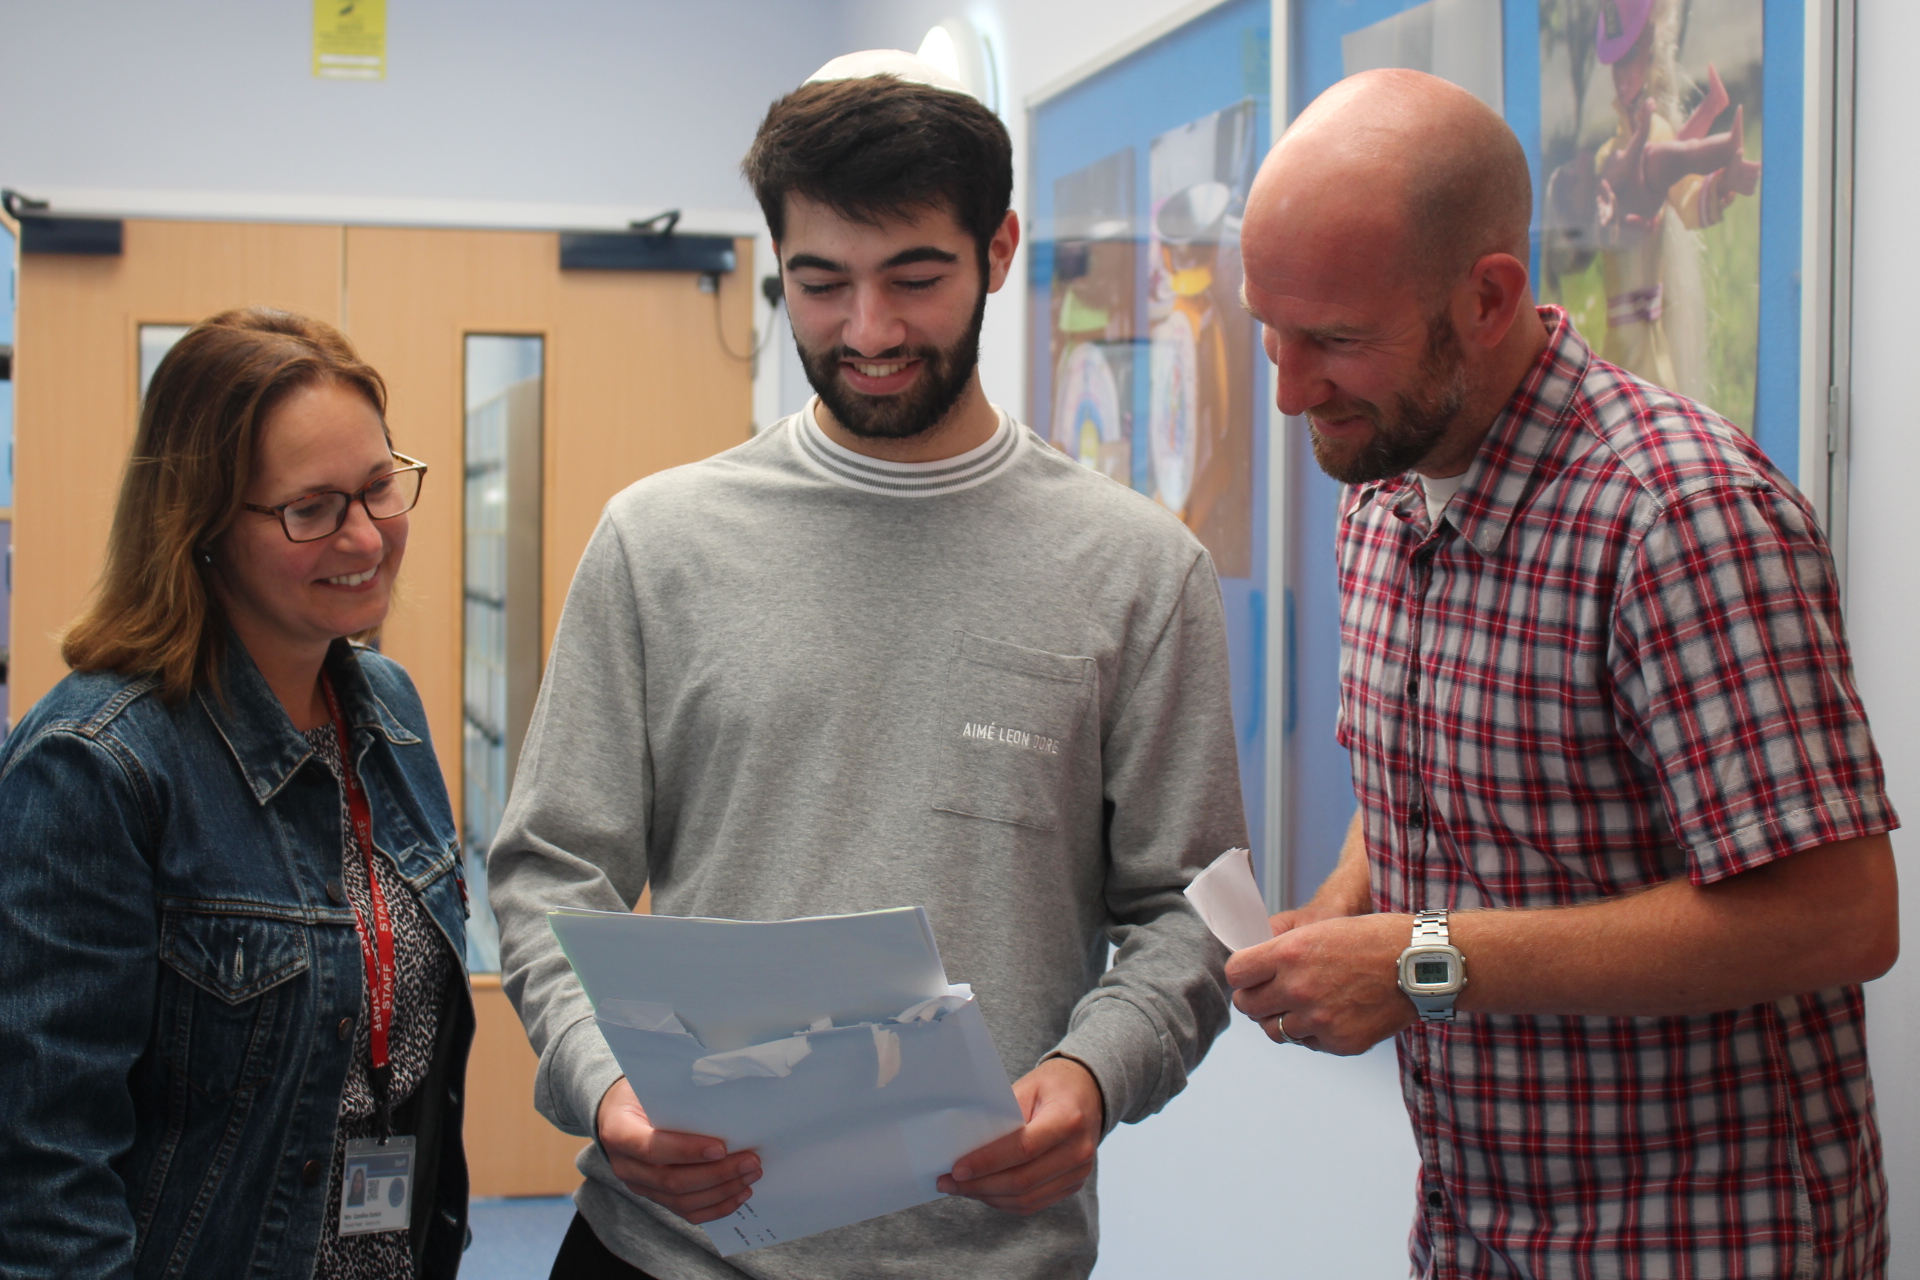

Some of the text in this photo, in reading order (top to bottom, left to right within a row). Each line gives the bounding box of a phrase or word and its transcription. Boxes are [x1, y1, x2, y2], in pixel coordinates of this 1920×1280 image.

[962, 721, 1060, 754] AIMÉ LEON DORE
[382, 963, 392, 1009] STAFF
